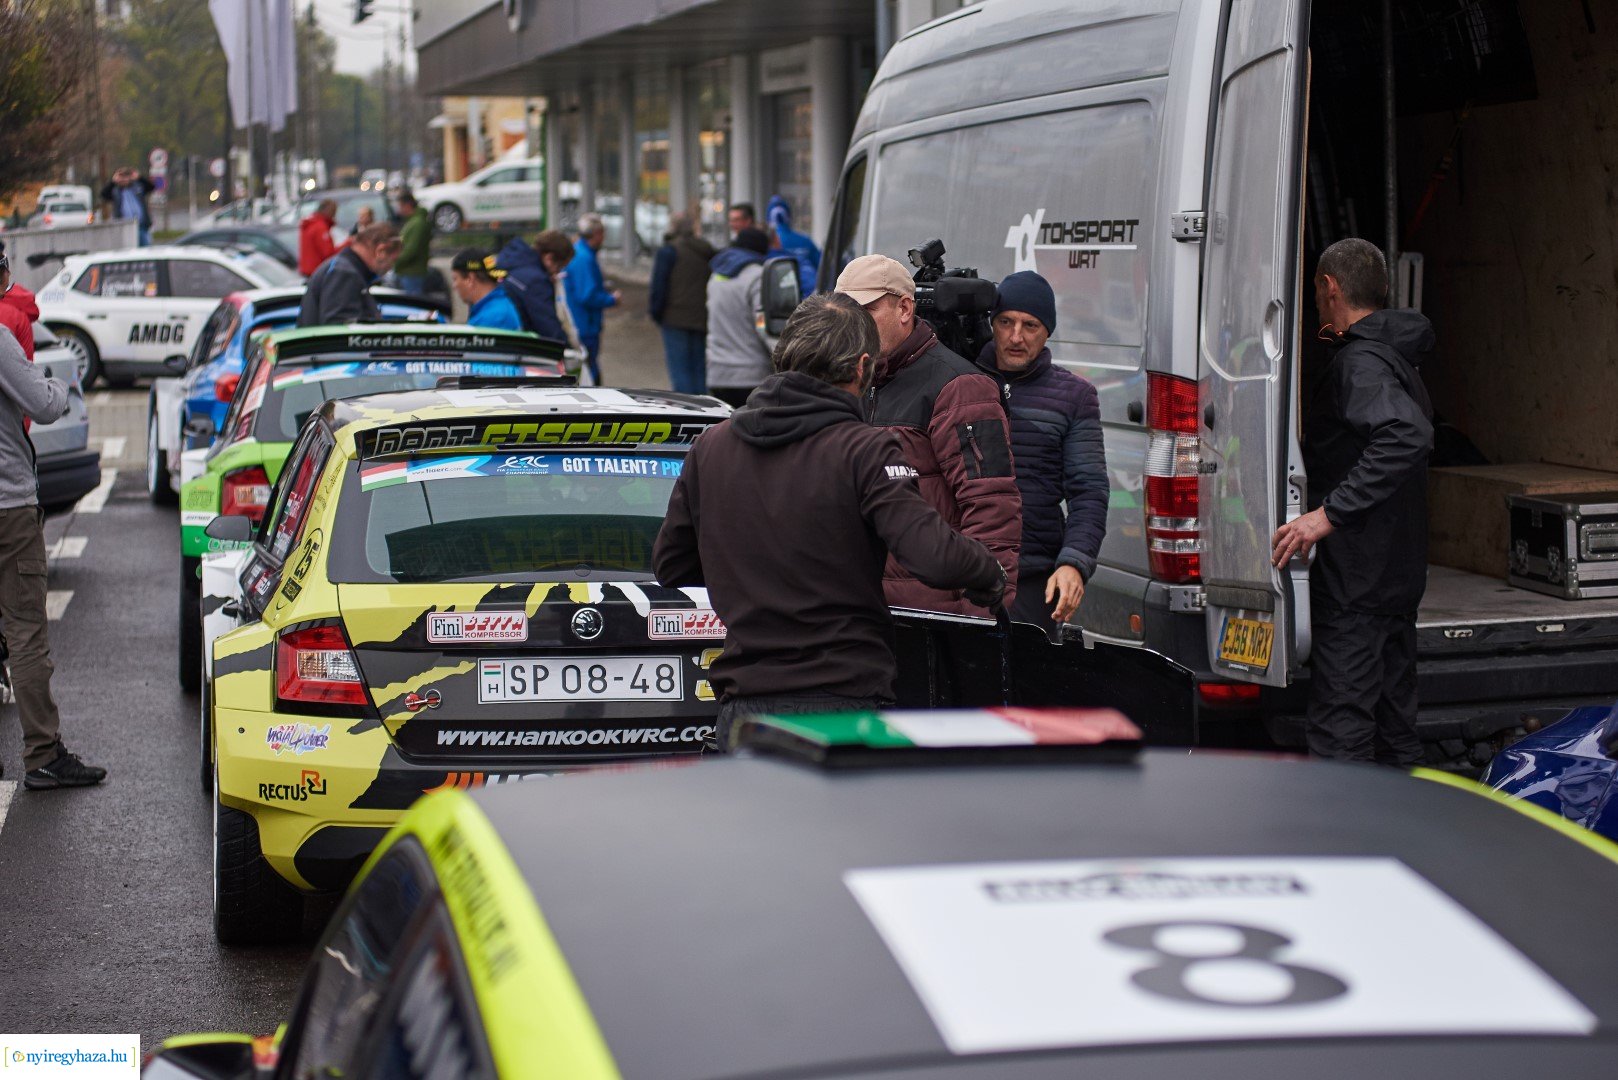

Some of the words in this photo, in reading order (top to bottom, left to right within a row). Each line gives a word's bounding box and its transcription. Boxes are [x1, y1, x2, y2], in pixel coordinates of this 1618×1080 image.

[1040, 219, 1139, 244] TOKSPORT
[1068, 249, 1100, 269] WRT
[347, 335, 496, 348] KordaRacing.hu
[405, 361, 426, 374] GOT
[562, 457, 591, 473] GOT
[594, 458, 658, 475] TALENT?
[661, 461, 683, 476] PR
[433, 618, 460, 636] Fini
[654, 615, 680, 633] Fini
[684, 628, 727, 636] KOMPRESS
[488, 683, 499, 694] H
[510, 664, 549, 695] SP
[561, 663, 675, 695] 08-48
[437, 725, 716, 746] WWW.HanKOOKWRC.CO
[258, 783, 308, 801] RECTUS
[1099, 918, 1352, 1011] 8
